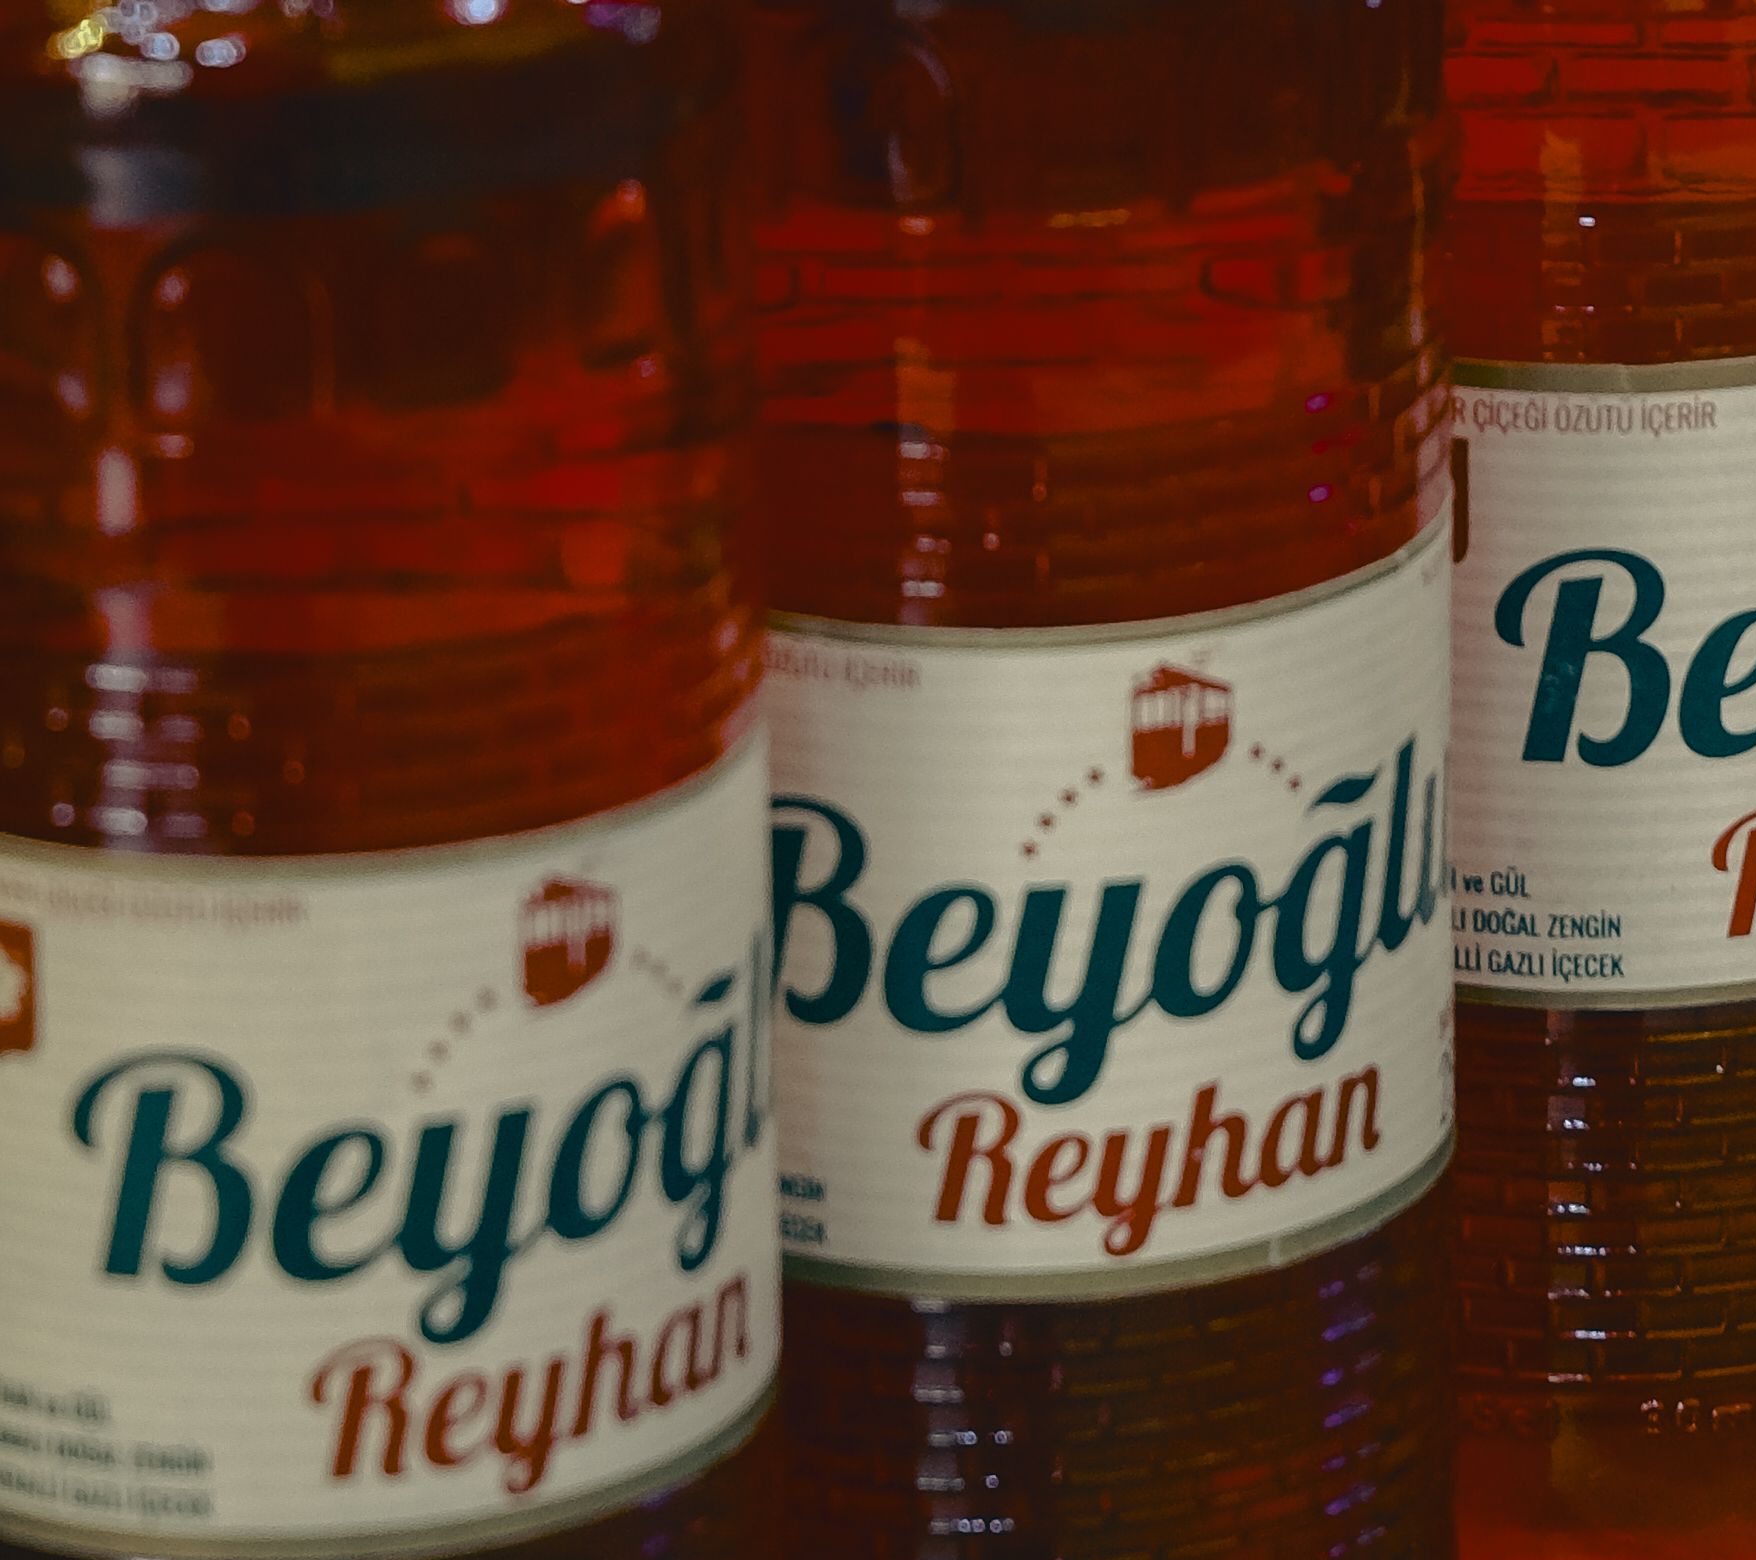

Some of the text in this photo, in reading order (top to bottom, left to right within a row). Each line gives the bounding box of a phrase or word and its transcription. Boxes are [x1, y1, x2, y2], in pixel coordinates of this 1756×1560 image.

[1641, 393, 1718, 437] İÇERİR
[1463, 874, 1483, 893] ve
[1491, 865, 1532, 898] GÜL
[1473, 908, 1540, 937] DOĞAL
[1547, 909, 1622, 939] ZENGİN
[1488, 949, 1544, 977] GAZLI
[1552, 948, 1625, 983] İÇECEK
[917, 1064, 1382, 1257] Reyhan
[309, 1276, 750, 1497] Reyhan
